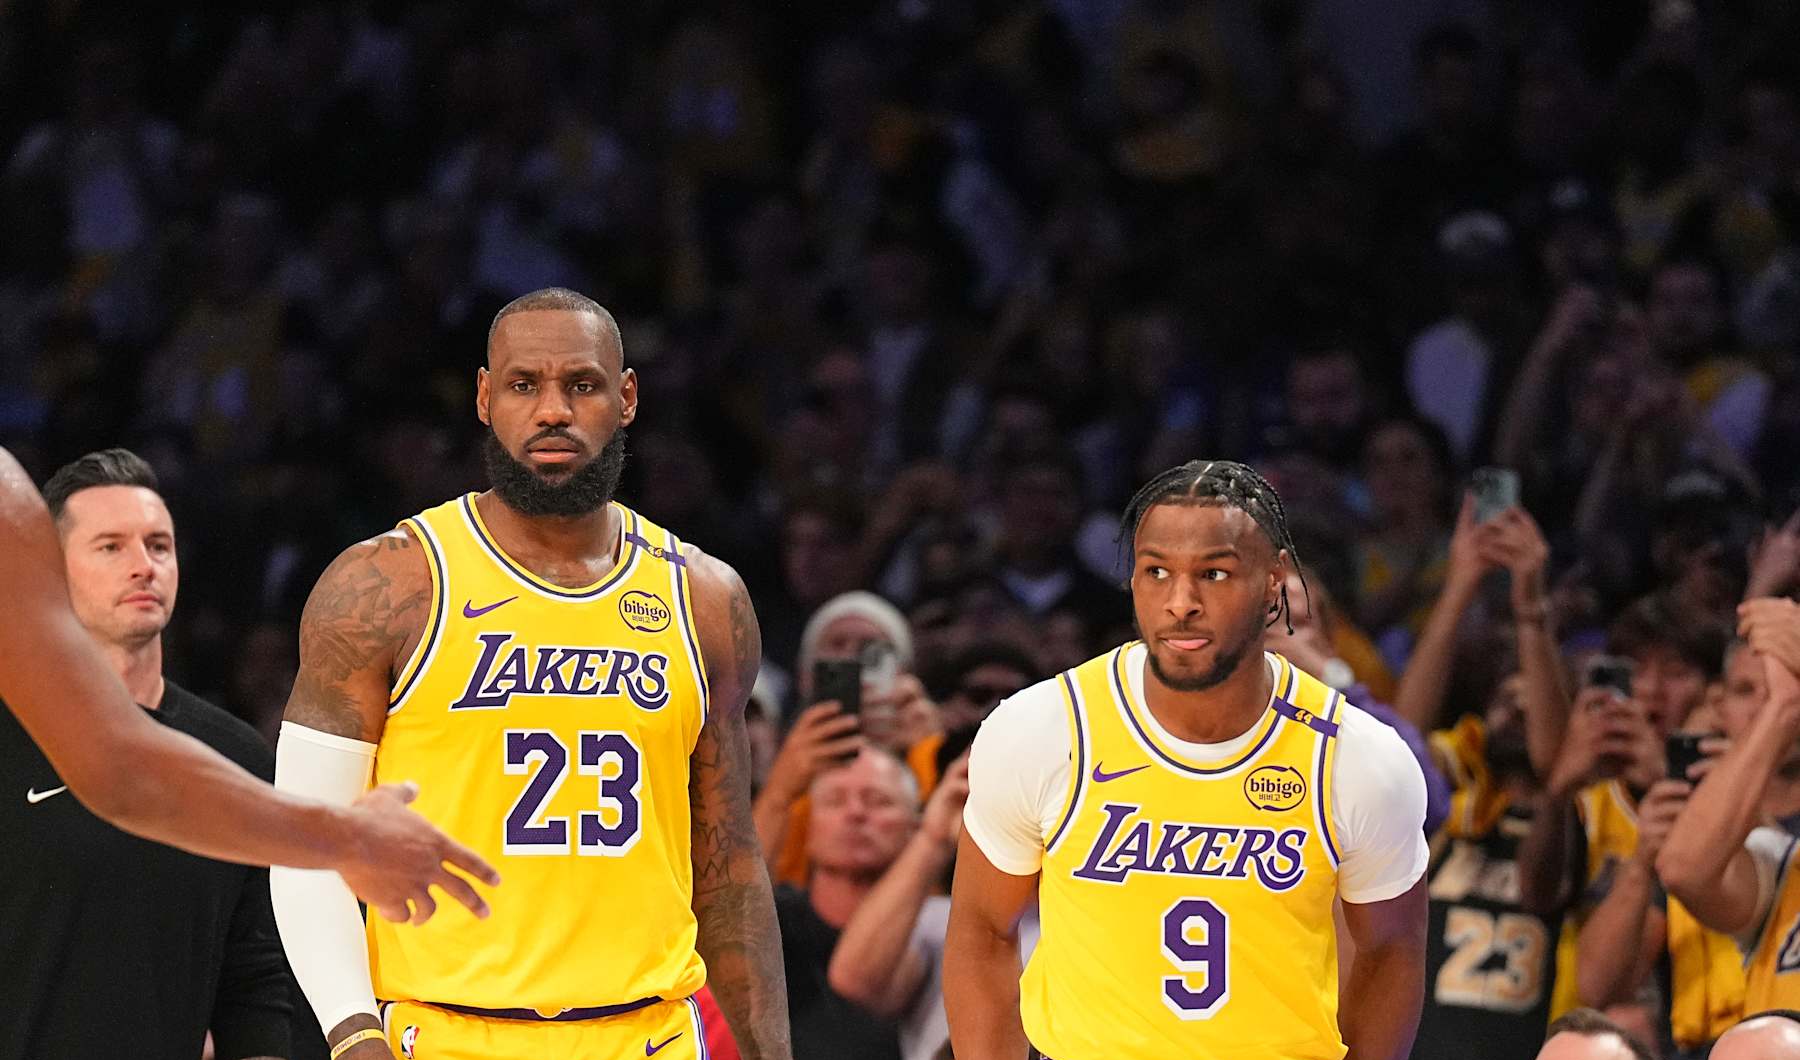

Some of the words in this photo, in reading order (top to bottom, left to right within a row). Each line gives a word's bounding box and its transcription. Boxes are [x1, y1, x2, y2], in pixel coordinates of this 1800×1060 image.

[624, 600, 667, 621] bibigo
[449, 632, 671, 712] LAKERS
[1295, 709, 1314, 725] 44
[503, 728, 642, 857] 23
[1250, 777, 1303, 798] bibigo
[1071, 801, 1308, 892] LAKERS
[1160, 896, 1230, 1021] 9
[1435, 907, 1546, 1012] 23
